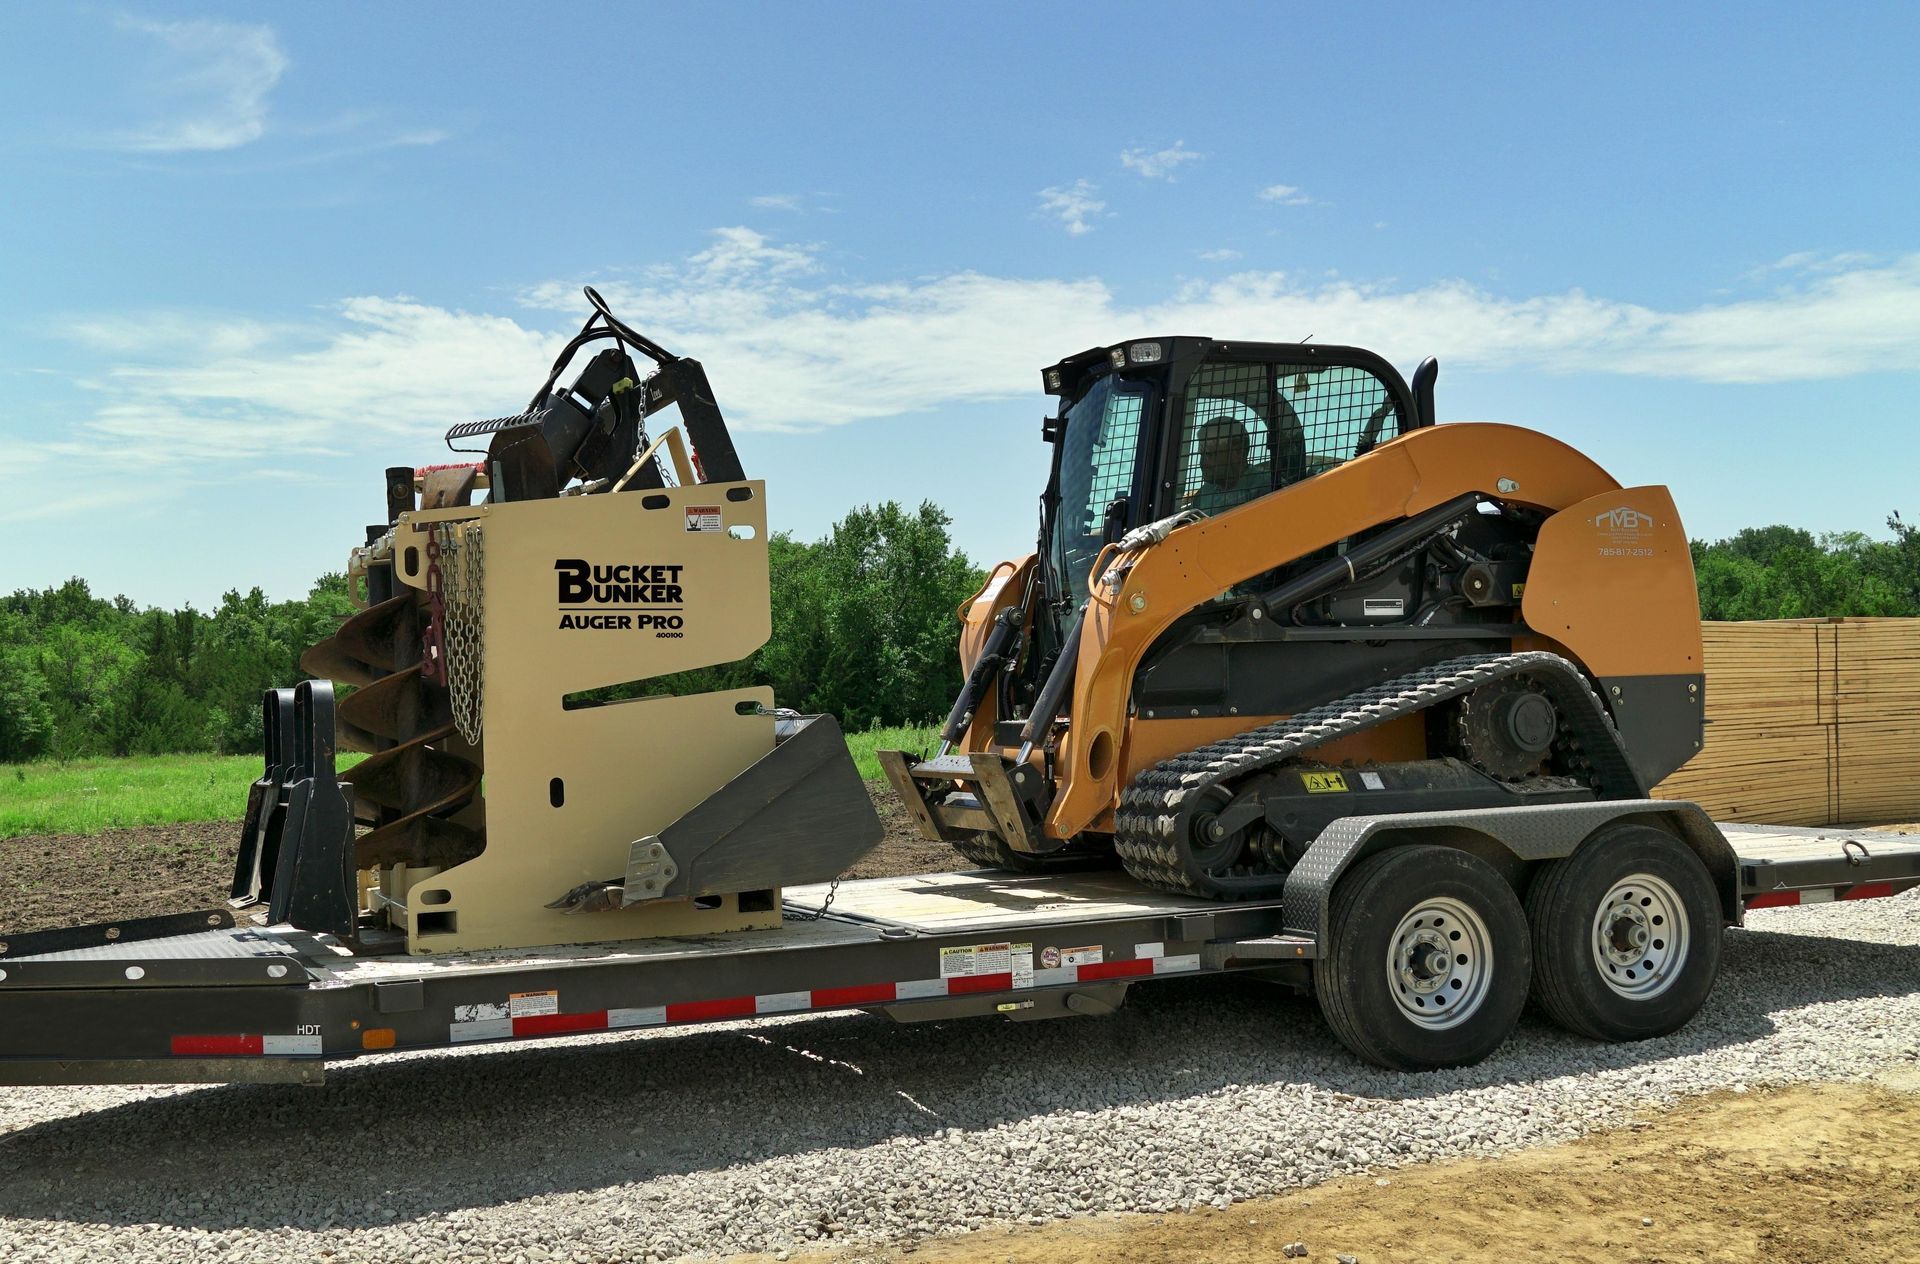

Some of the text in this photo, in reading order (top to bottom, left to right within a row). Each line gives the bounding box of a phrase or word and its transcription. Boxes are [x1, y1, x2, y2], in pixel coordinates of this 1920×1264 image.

[1599, 548, 1653, 556] 785-817-2512
[554, 559, 683, 583] BUCKET
[558, 581, 683, 603] BUNKER
[559, 615, 683, 629] AUGER PRO
[984, 944, 1009, 952] WARNING
[297, 1024, 321, 1035] HDT
